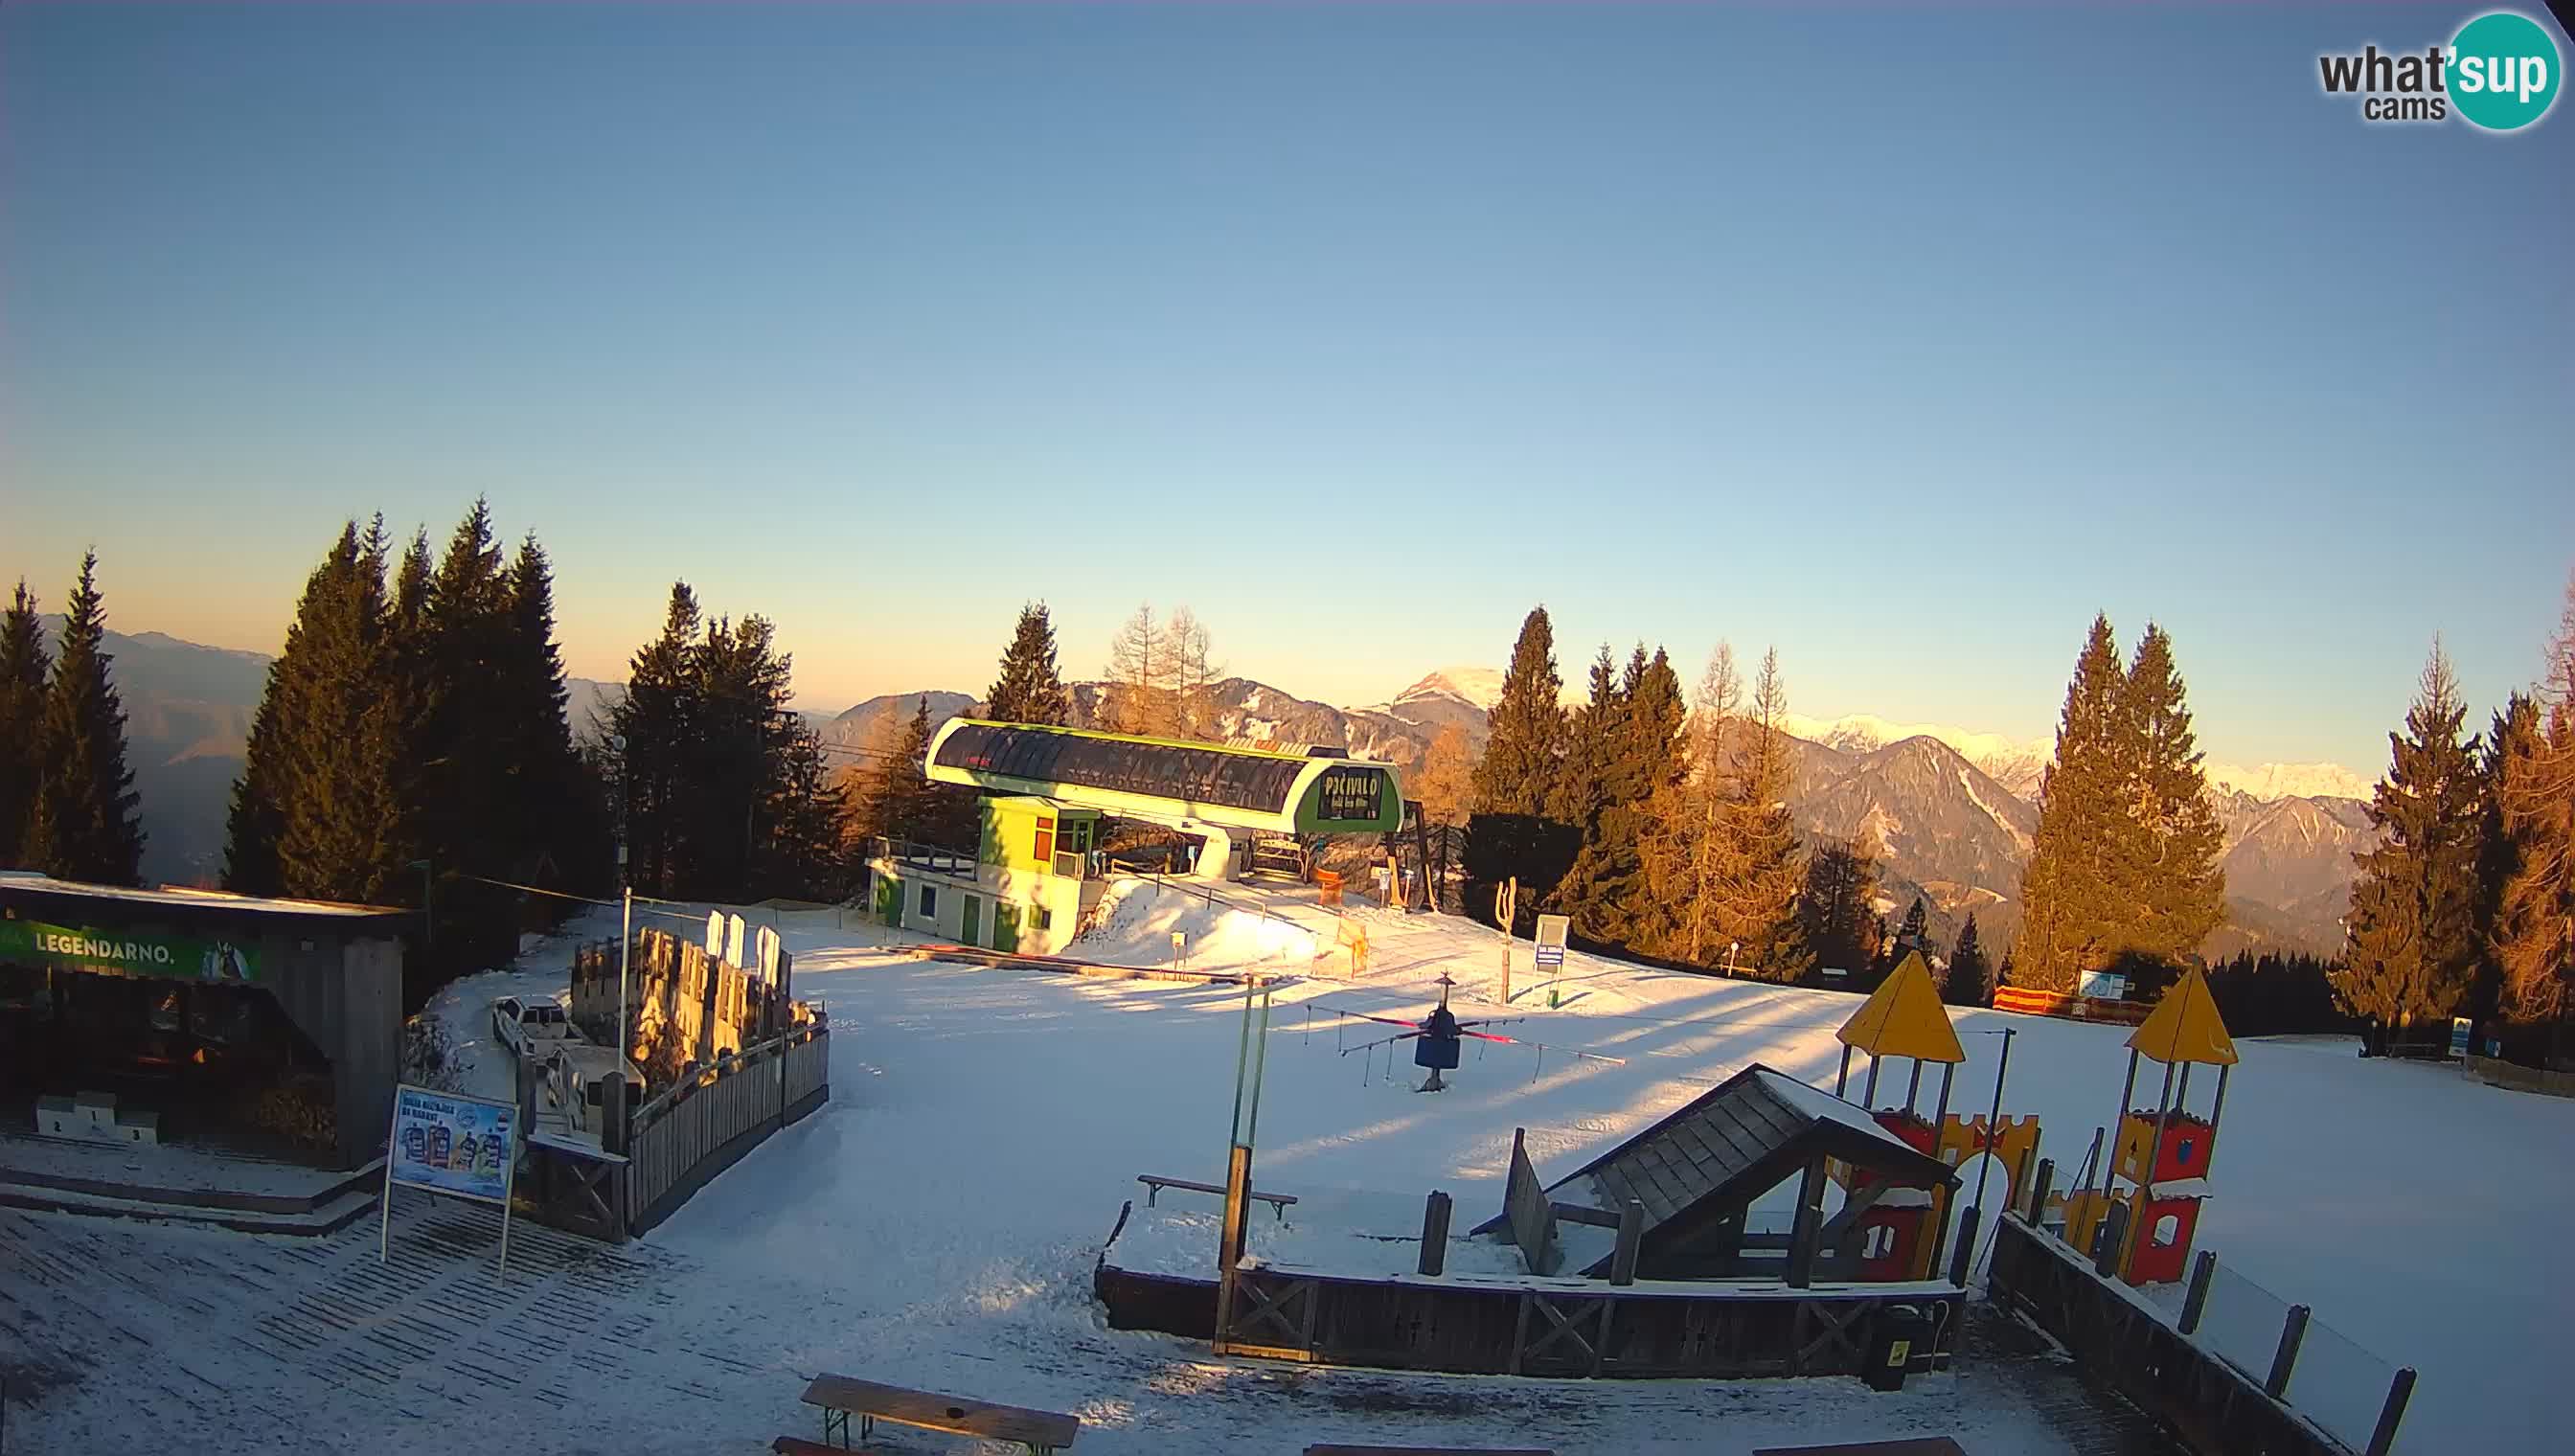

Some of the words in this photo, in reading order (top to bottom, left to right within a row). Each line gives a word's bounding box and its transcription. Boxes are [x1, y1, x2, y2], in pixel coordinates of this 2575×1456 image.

[35, 933, 175, 965] LEGENDARNO.
[54, 1121, 62, 1132] 2
[132, 1129, 141, 1141] 3
